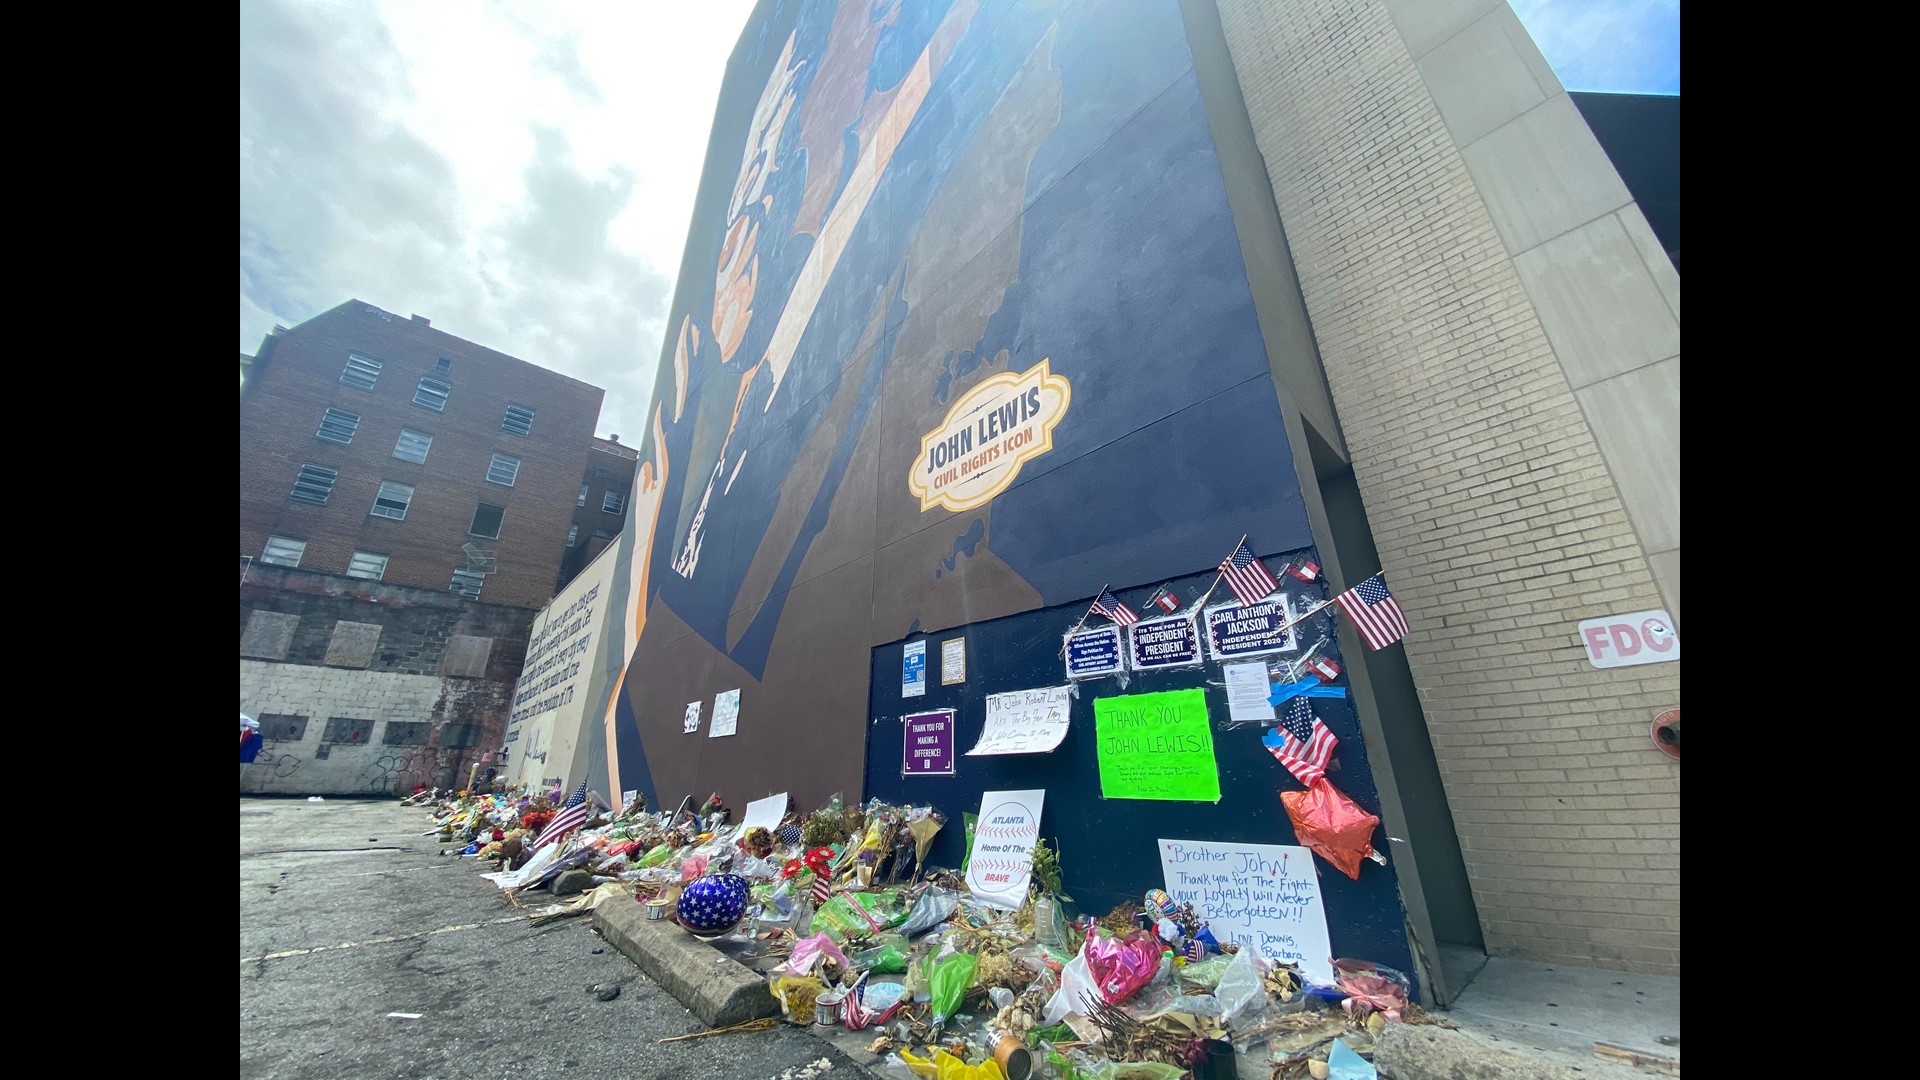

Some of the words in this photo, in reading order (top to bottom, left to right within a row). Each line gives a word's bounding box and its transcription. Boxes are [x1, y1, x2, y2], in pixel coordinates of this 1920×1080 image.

[928, 425, 972, 474] JOHN
[978, 385, 1041, 446] LEWIS
[934, 466, 958, 490] CIVIL
[961, 444, 1000, 476] RIGHTS
[1003, 427, 1033, 454] ICON
[1215, 611, 1236, 624] CARL
[1237, 603, 1276, 620] ANTHONY
[1227, 617, 1269, 635] JACKSON
[1140, 628, 1187, 644] INDEPENDENT
[1584, 618, 1673, 660] FDC
[1145, 641, 1184, 655] PRESIDENT
[1222, 641, 1261, 651] PRESIDENT
[1104, 707, 1148, 729] THANK
[1157, 706, 1182, 724] YOU
[912, 724, 926, 733] THANK
[927, 723, 935, 731] YOU
[936, 722, 944, 730] FOR
[918, 736, 934, 745] MAKING
[935, 735, 938, 744] A
[1105, 737, 1140, 755] JOHN
[1147, 734, 1210, 753] LEWIS!!
[914, 748, 942, 758] DIFFERENCE!
[992, 816, 1024, 824] ATLANTA
[981, 844, 1001, 852] Home
[1002, 844, 1011, 852] Of
[1012, 844, 1025, 853] The
[1171, 844, 1230, 863] Brother
[984, 873, 1010, 882] BRAVE
[1212, 875, 1229, 893] you
[1232, 871, 1248, 886] for
[1252, 876, 1275, 888] The
[1253, 891, 1272, 901] Will
[1276, 893, 1314, 905] Never
[1261, 946, 1307, 961] Barbara
